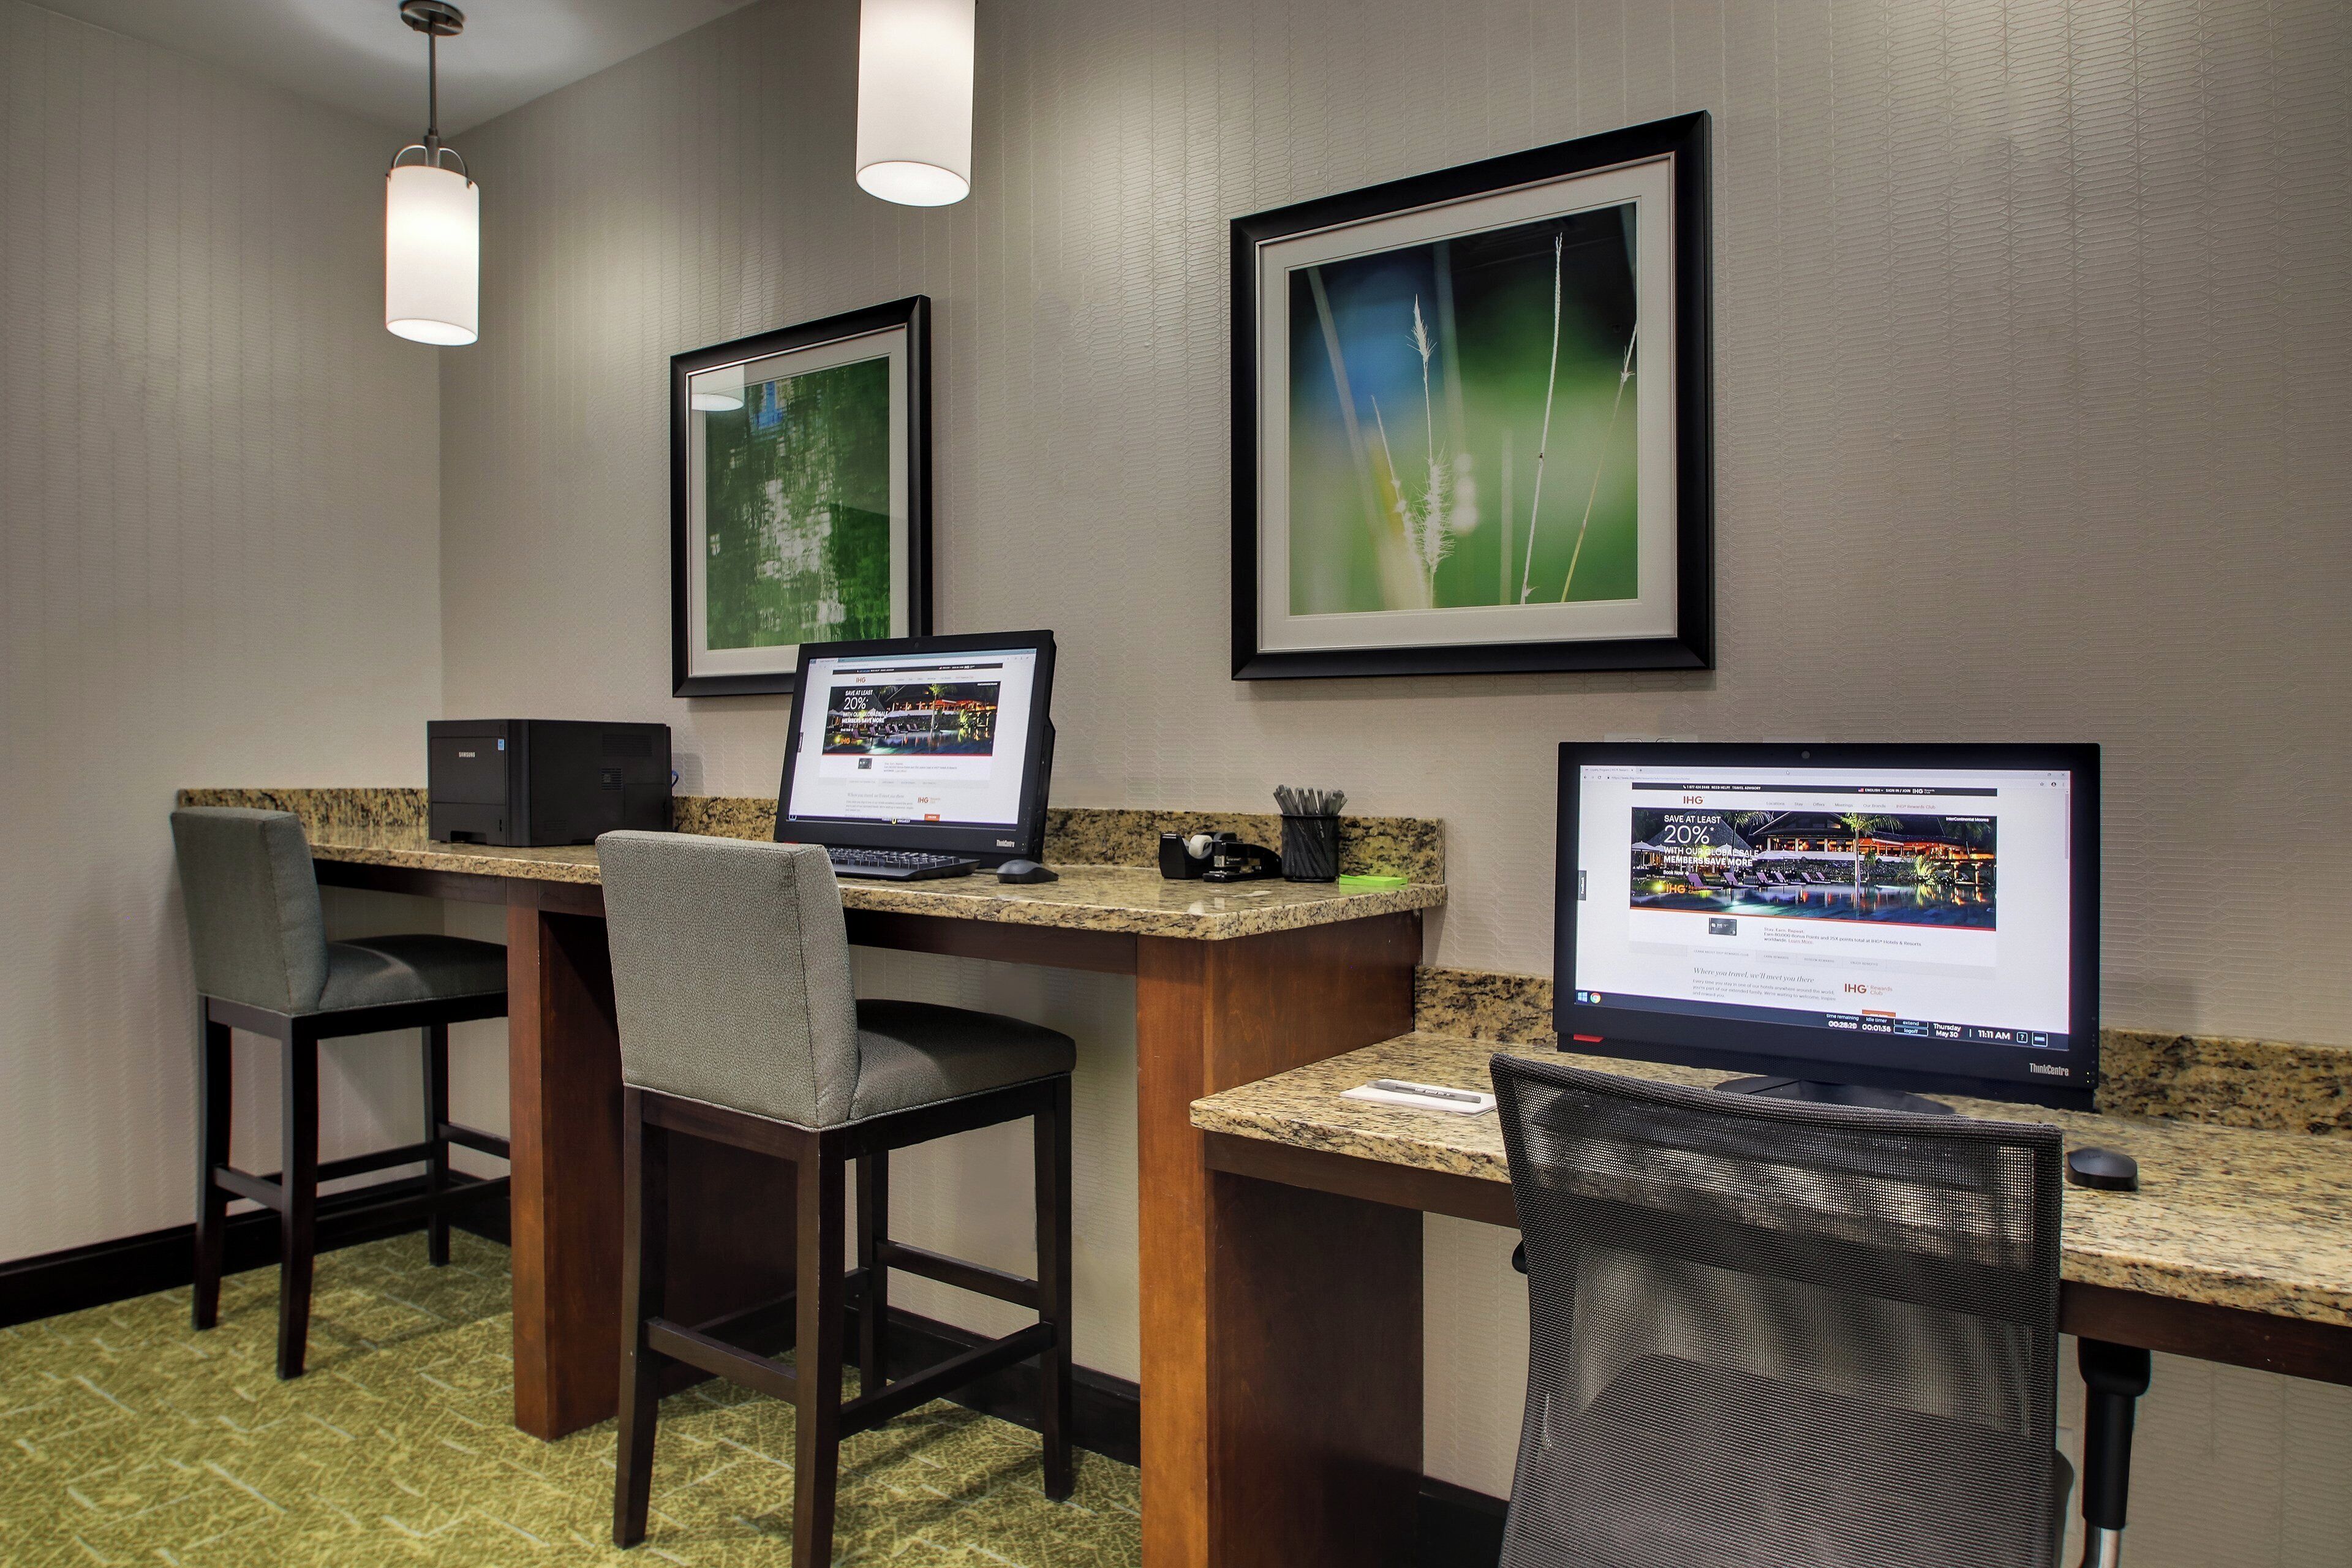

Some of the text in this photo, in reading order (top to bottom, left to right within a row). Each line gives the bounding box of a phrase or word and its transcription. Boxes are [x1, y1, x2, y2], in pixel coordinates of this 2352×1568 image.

[1683, 796, 1703, 804] IHG
[1664, 846, 1684, 855] WITH
[1686, 847, 1705, 856] OUR
[1664, 856, 1703, 864] MEMBERS
[1727, 858, 1753, 867] MORE
[1666, 884, 1686, 894] IHG
[1844, 983, 1867, 994] IHG
[1933, 1022, 1961, 1033] Thursday
[1936, 1029, 1949, 1038] May
[1978, 1030, 2011, 1041] 11:11 AM
[2029, 1063, 2069, 1076] ThinkCentre
